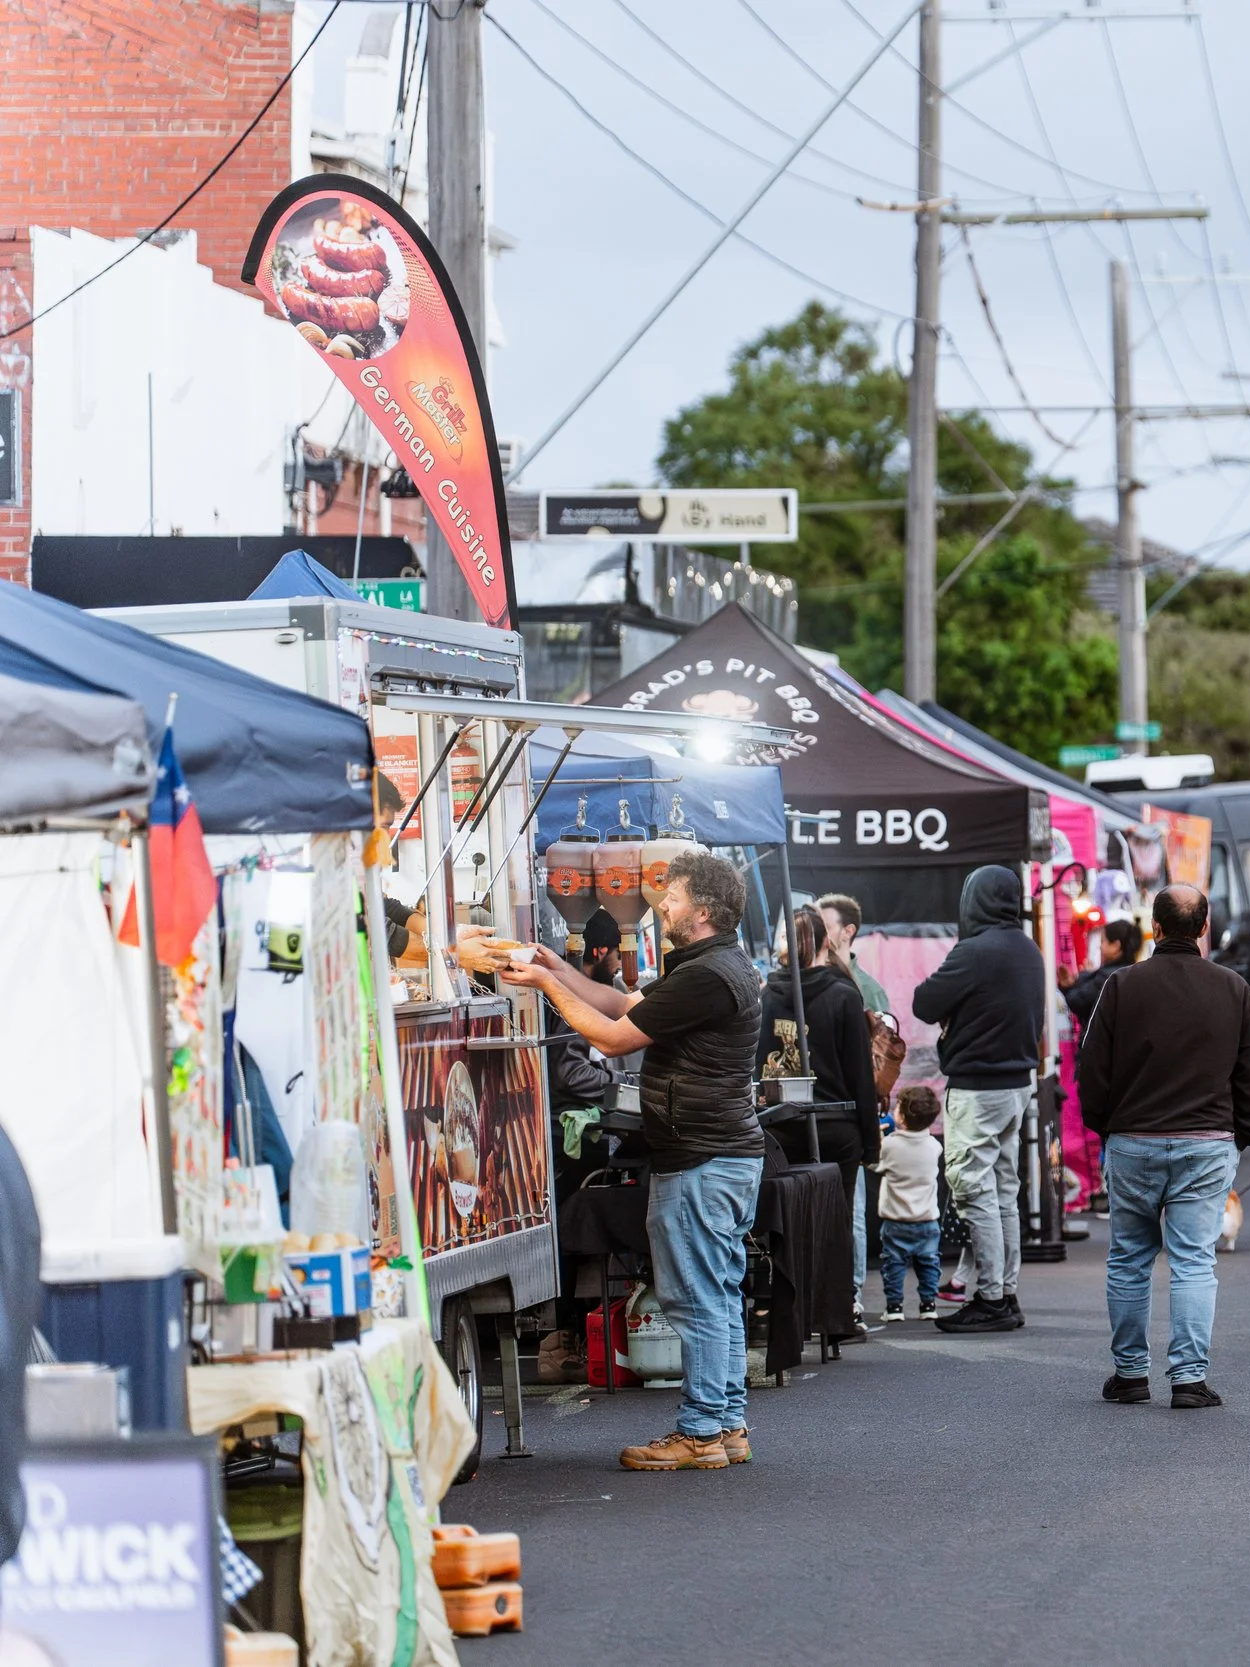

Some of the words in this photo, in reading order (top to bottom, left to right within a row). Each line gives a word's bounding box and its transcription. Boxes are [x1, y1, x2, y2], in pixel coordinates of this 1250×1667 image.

[411, 382, 461, 445] Master
[360, 366, 435, 473] German
[438, 479, 495, 587] Cuisine
[622, 659, 715, 711] BRAD'S
[725, 657, 777, 684] PIT
[774, 684, 821, 724] BBQ
[856, 808, 950, 852] BBQ
[1, 1520, 199, 1585] WICK
